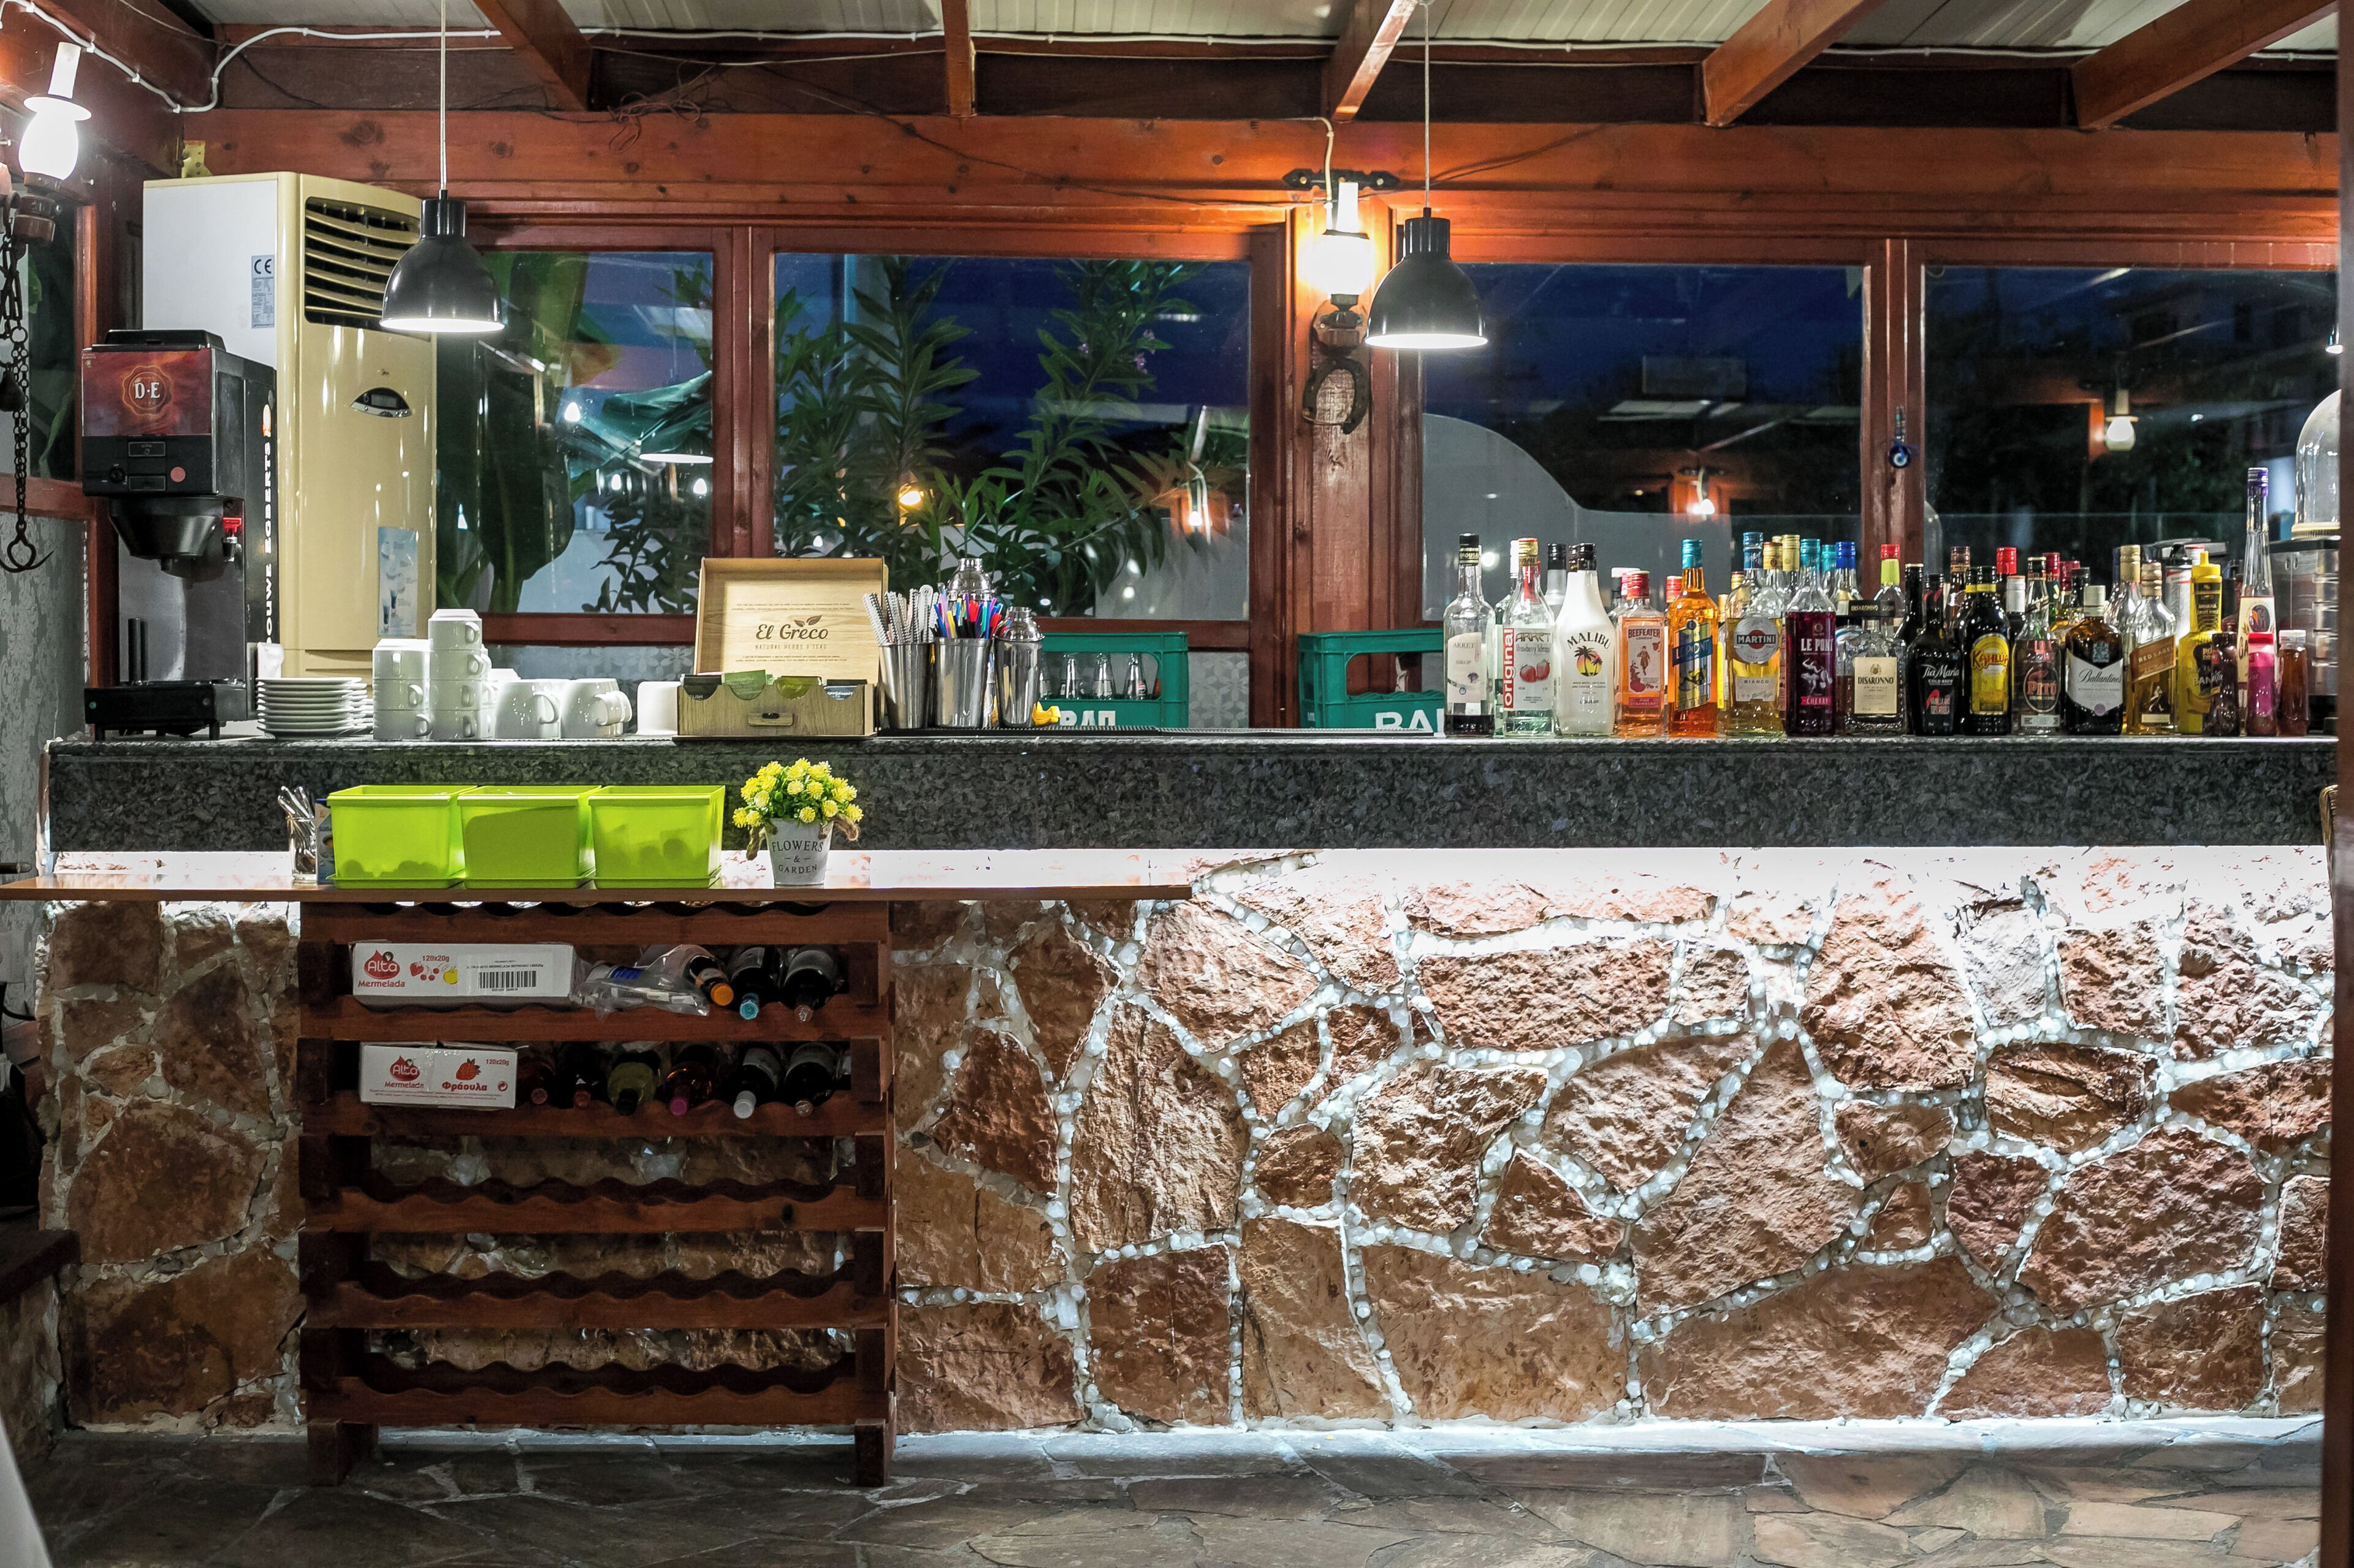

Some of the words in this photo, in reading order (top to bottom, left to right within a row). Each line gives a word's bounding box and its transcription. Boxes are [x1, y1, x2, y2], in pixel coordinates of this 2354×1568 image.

[756, 623, 774, 639] El
[779, 623, 828, 639] Greco
[1628, 628, 1661, 638] BEEFEATER
[1567, 631, 1611, 650] MALIBU
[1738, 635, 1775, 644] MARTINI
[1801, 638, 1812, 651] LE
[1504, 628, 1515, 706] original
[772, 840, 824, 852] FLOWERS
[779, 864, 818, 874] GARDEN
[368, 960, 398, 973] Alta
[392, 1065, 418, 1076] Alta
[441, 1081, 488, 1092] Φράουλα
